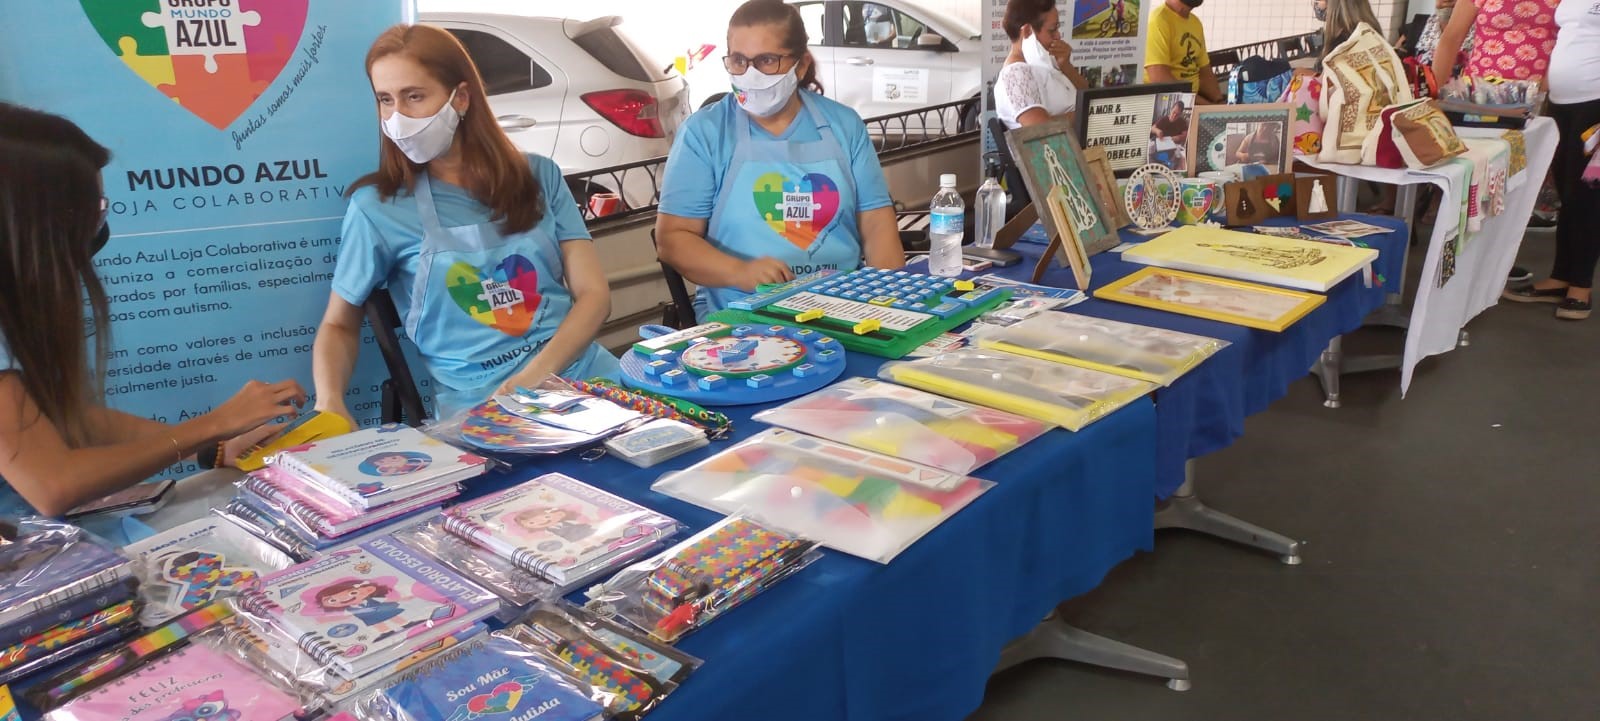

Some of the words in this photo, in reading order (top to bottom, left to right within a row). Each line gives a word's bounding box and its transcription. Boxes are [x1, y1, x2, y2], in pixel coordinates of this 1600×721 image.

[171, 9, 231, 18] MUNDO
[176, 19, 237, 47] AZUL
[232, 114, 267, 150] Juntas
[268, 84, 294, 117] somos
[293, 60, 312, 87] mais
[1089, 104, 1113, 115] AMOR
[1116, 104, 1121, 113] &
[1113, 115, 1136, 125] ARTE
[1087, 134, 1130, 147] CAROLINA
[1106, 148, 1142, 160] OBREGA
[126, 164, 245, 191] MUNDO
[255, 159, 328, 183] AZUL
[111, 199, 157, 216] OJA
[173, 184, 345, 210] COLABORATIV
[785, 194, 810, 202] GRUPO
[785, 206, 810, 218] AZUL
[92, 253, 132, 267] undo
[136, 249, 168, 263] Azul
[171, 248, 203, 262] Loja
[205, 240, 296, 257] Colaborativa
[300, 237, 308, 248] é
[311, 237, 331, 247] um
[165, 271, 175, 280] a
[186, 256, 312, 277] comercialização
[163, 288, 186, 300] por
[258, 272, 334, 288] especialme
[492, 289, 520, 307] AZUL
[138, 308, 170, 319] com
[173, 301, 232, 315] autismo.
[137, 344, 178, 355] como
[186, 336, 236, 349] valores
[243, 334, 253, 343] a
[261, 326, 316, 340] inclusão
[177, 353, 229, 368] através
[235, 349, 252, 361] de
[259, 346, 288, 358] uma
[480, 344, 532, 370] MUNDO
[181, 373, 217, 388] justa.
[370, 538, 421, 568] ESCOLAR
[128, 676, 177, 702] FELIZ
[446, 683, 477, 702] Sou
[477, 666, 510, 686] Mãe
